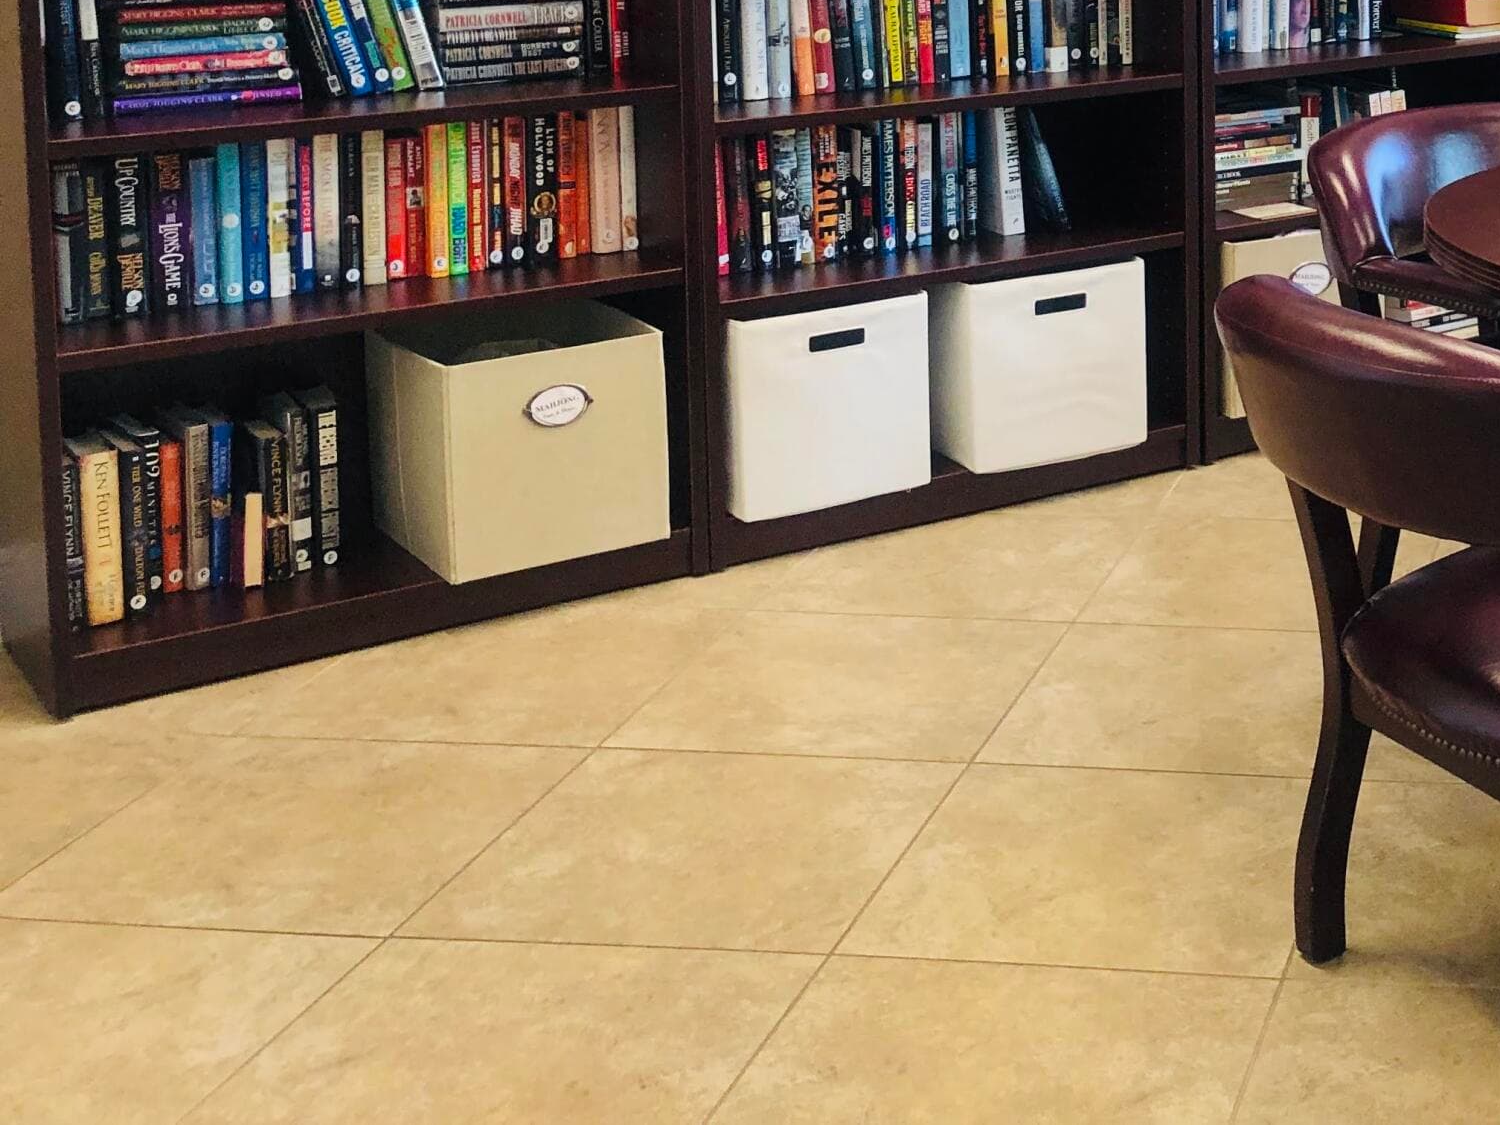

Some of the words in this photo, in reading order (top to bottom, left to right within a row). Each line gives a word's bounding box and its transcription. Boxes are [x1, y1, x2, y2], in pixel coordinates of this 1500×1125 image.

[446, 15, 483, 29] PATRICIA
[485, 11, 527, 25] CORNWELL
[889, 5, 898, 33] LAURA
[1372, 1, 1382, 30] Forever
[592, 18, 604, 52] COULTER
[892, 35, 901, 74] LIPPMAN
[471, 122, 482, 143] Janet
[545, 128, 554, 154] LION
[862, 137, 871, 154] JAMES
[883, 120, 893, 154] JAMES
[115, 157, 138, 176] UP
[471, 146, 483, 183] Evanovich
[509, 143, 520, 178] MONDAY
[535, 118, 545, 186] HOLLYWOOD
[546, 159, 554, 173] OF
[1006, 136, 1020, 182] PANETTA
[862, 155, 872, 187] PATTERSON
[884, 154, 894, 217] PATTERSON
[945, 173, 956, 196] CROSS
[967, 168, 977, 187] JAMES
[87, 197, 104, 240] DEAVER
[114, 177, 138, 227] COUNTRY
[302, 190, 313, 229] BEFORE
[816, 162, 839, 241] EXILE
[946, 198, 956, 211] THE
[159, 222, 183, 254] LION'S
[510, 207, 522, 235] JIHAD
[130, 252, 144, 289] NELSON
[159, 254, 184, 291] GAME
[271, 440, 281, 476] VINCE
[62, 471, 73, 512] VINCE
[94, 461, 110, 490] KEN
[272, 478, 281, 512] FLYNN
[96, 492, 113, 549] FOLLETT
[133, 505, 142, 527] WILD
[65, 515, 74, 556] FLYNN
